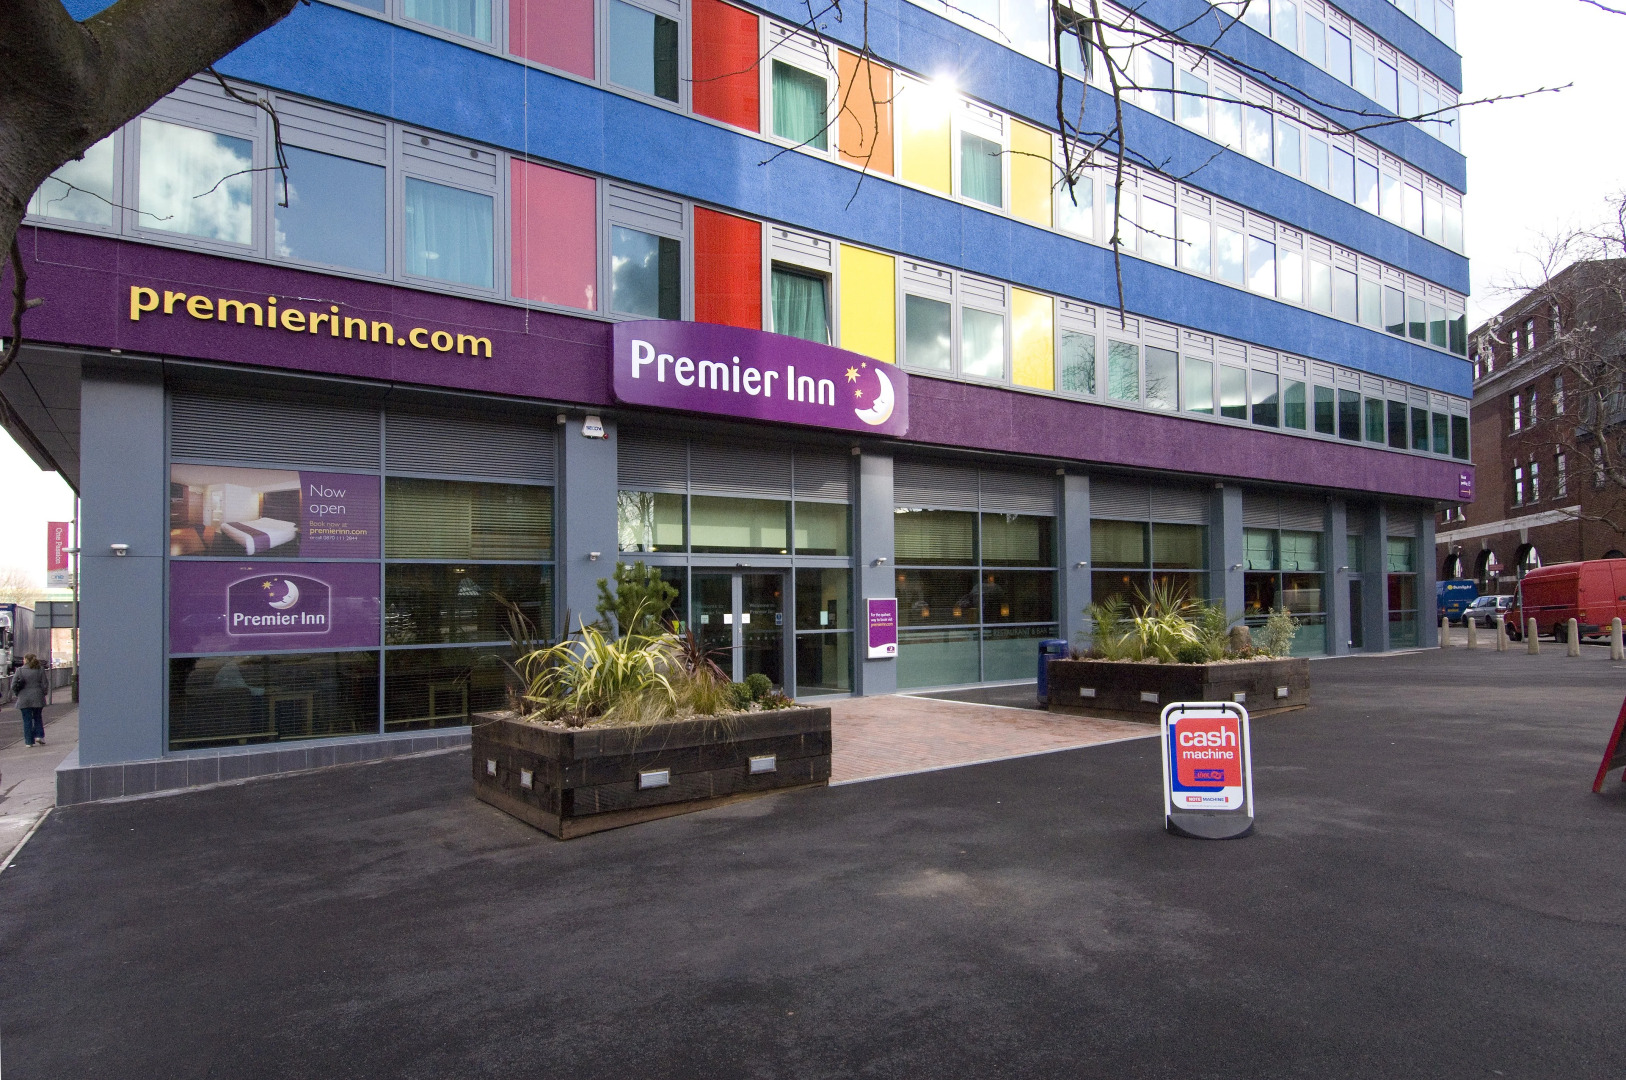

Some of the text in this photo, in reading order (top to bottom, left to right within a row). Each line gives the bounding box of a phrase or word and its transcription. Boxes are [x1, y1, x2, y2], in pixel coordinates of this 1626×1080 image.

[129, 284, 493, 358] premierinn.com
[631, 339, 835, 406] Premier Inn
[310, 484, 347, 498] Now
[309, 504, 346, 517] open
[309, 527, 368, 536] premierinn.com
[233, 611, 325, 626] Premier Inn
[1179, 725, 1236, 747] cash
[1183, 748, 1234, 760] machine
